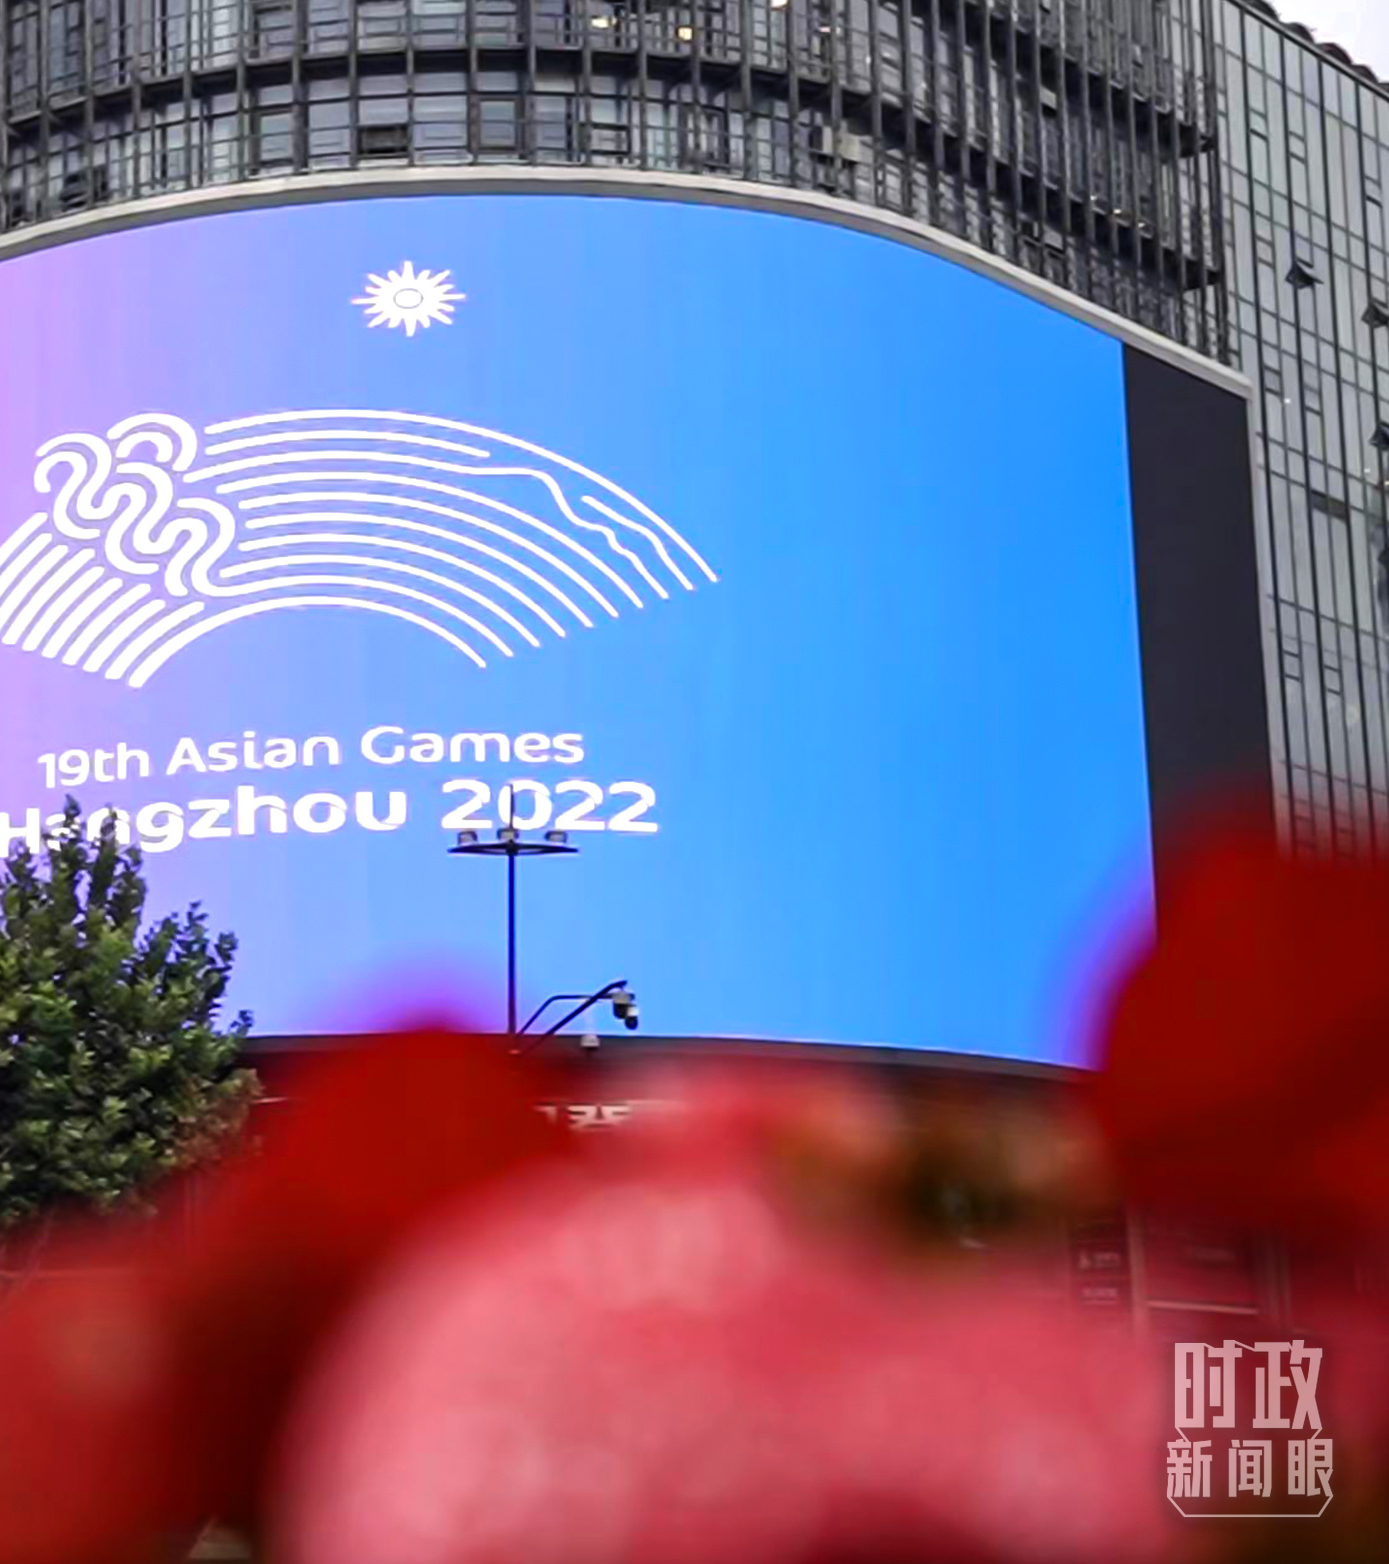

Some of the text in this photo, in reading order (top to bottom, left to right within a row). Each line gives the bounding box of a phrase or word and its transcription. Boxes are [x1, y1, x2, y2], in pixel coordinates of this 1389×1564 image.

[37, 725, 584, 789] 19th Asian Games
[441, 778, 658, 833] 2022
